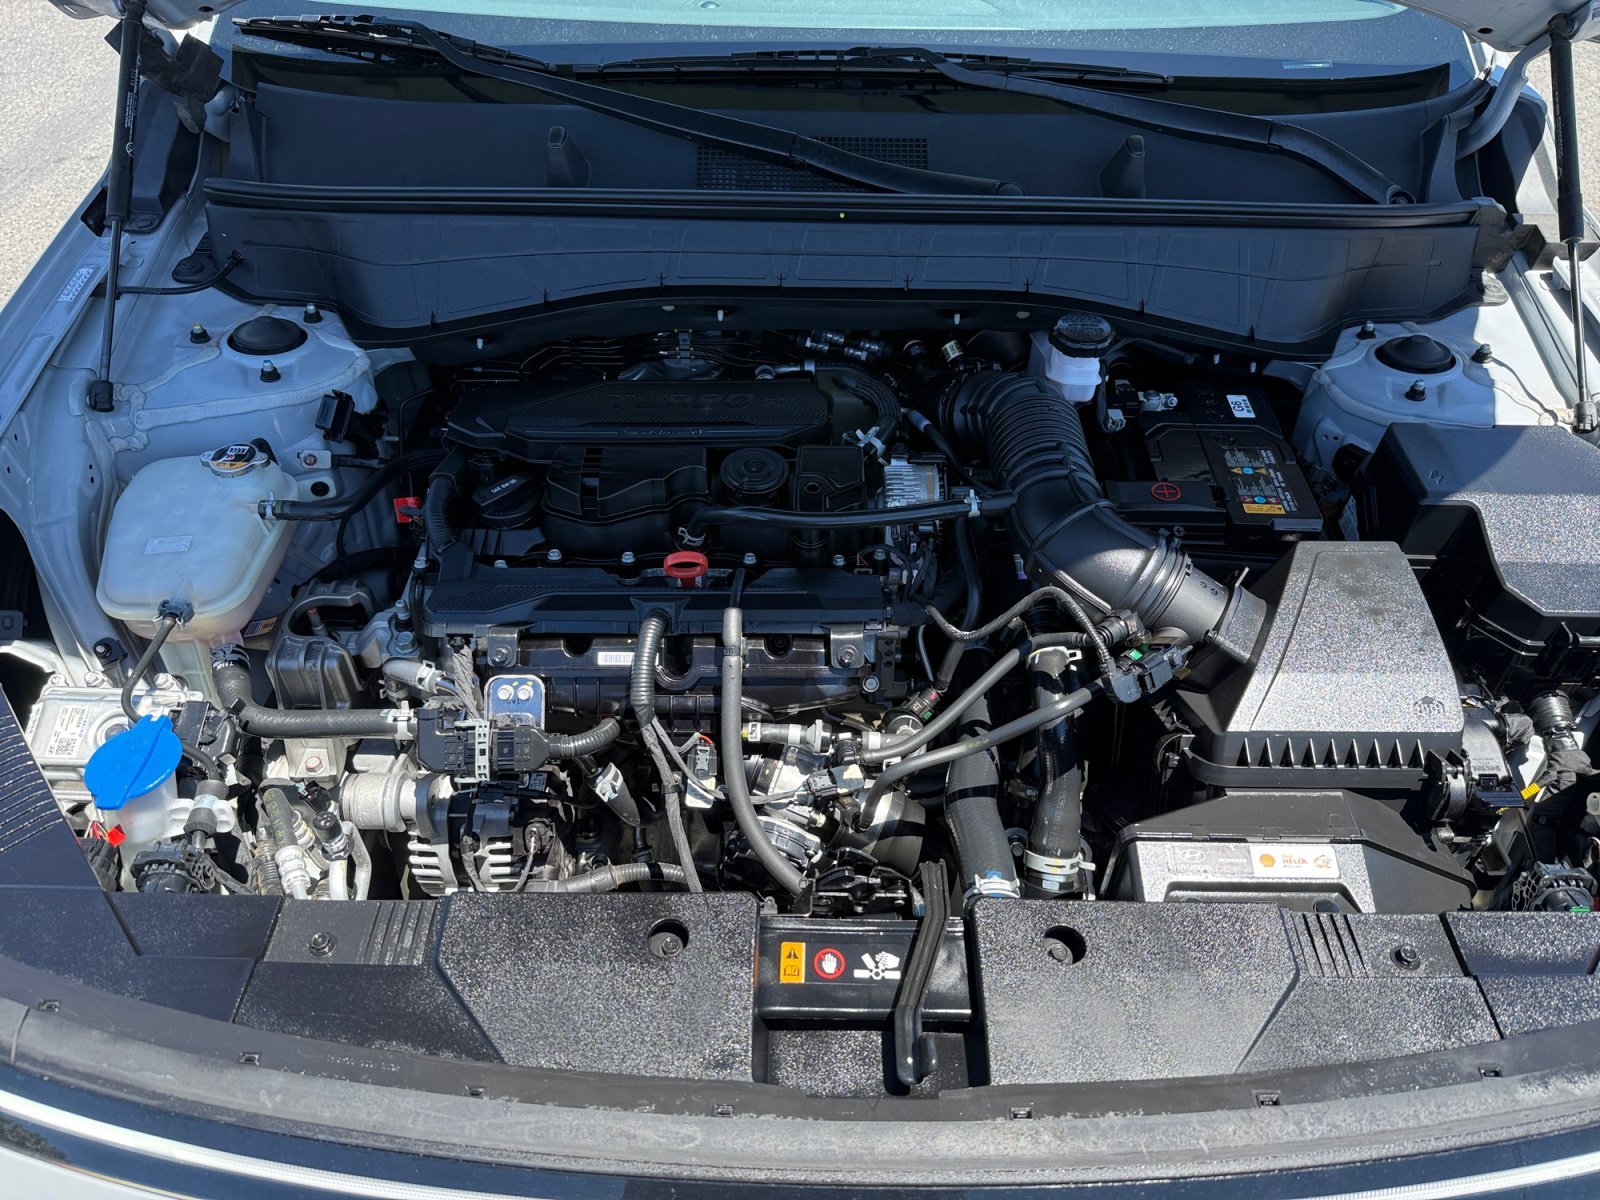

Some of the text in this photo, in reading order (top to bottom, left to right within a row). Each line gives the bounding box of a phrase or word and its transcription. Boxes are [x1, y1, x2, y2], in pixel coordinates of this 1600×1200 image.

[608, 393, 756, 409] TURBO
[1231, 400, 1244, 412] G6
[1282, 857, 1309, 865] HELIX
[1176, 863, 1211, 871] HYUNDAI
